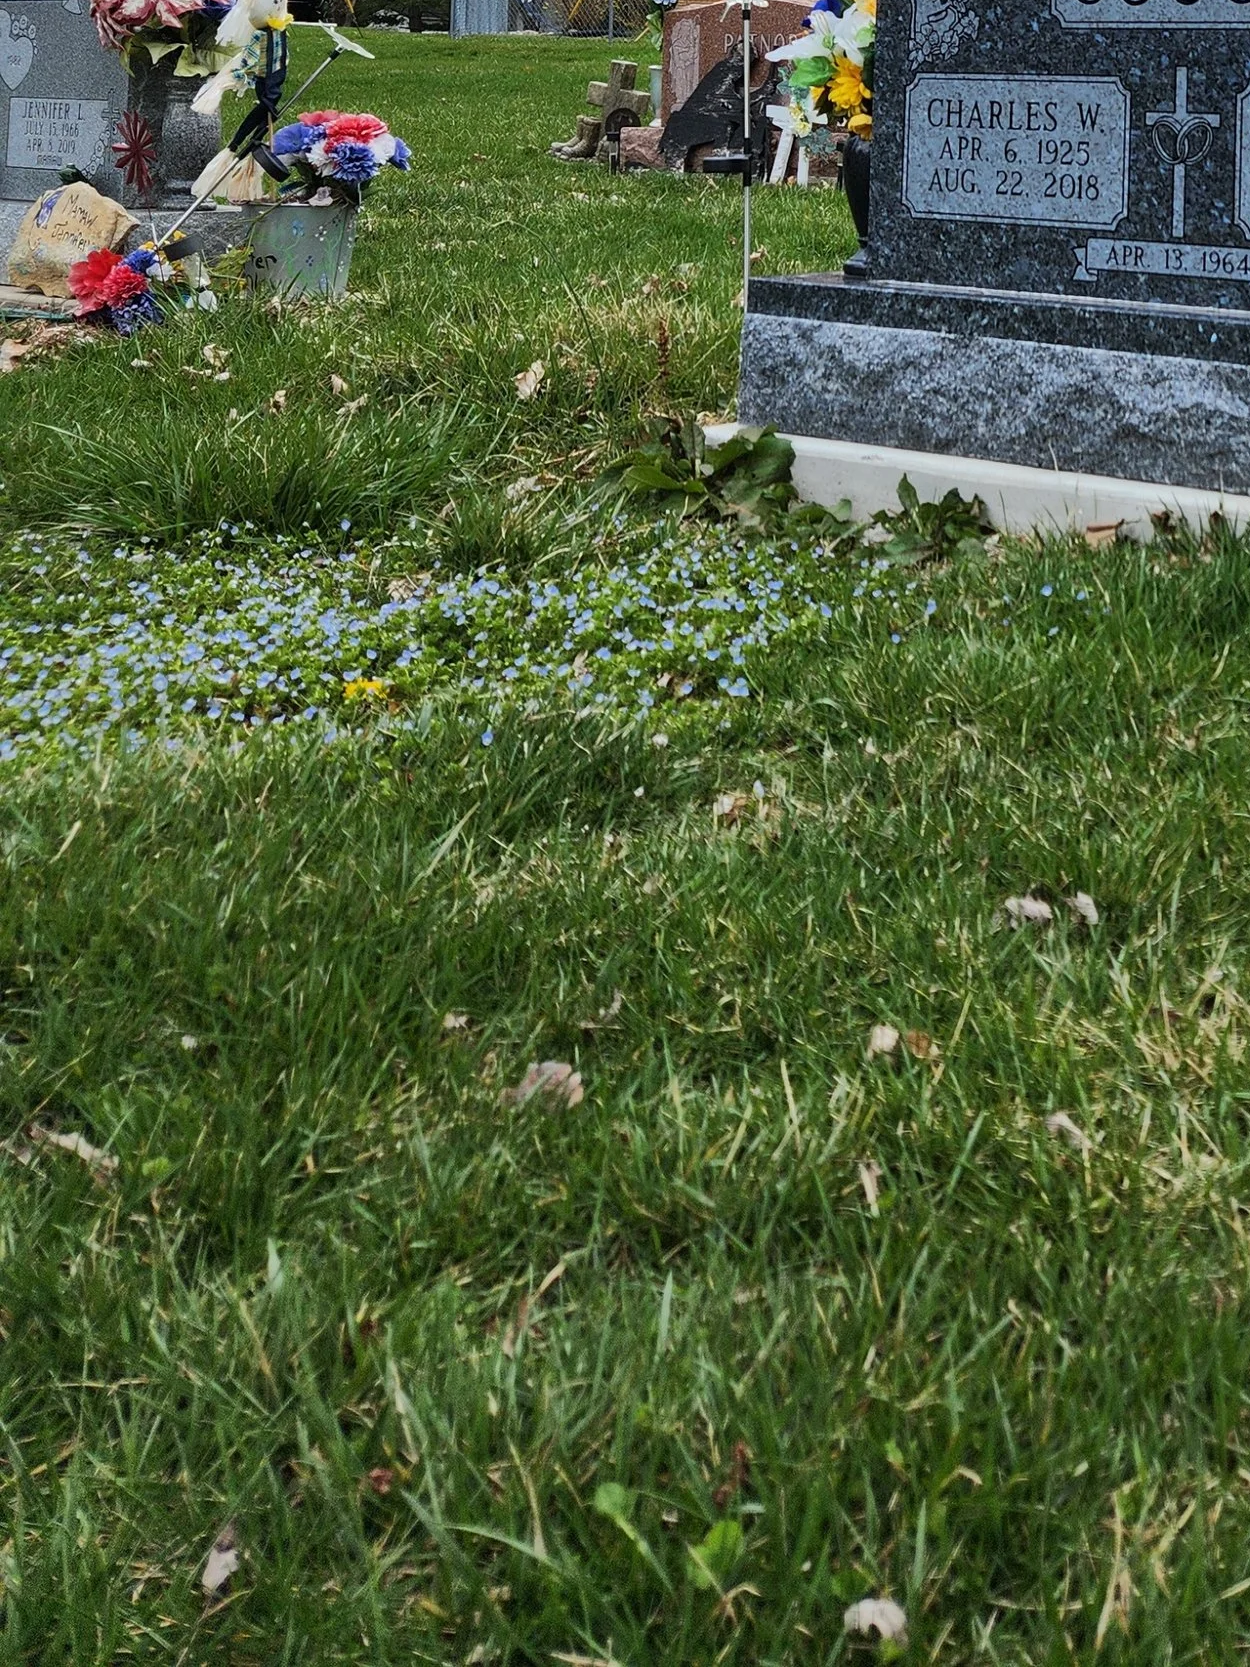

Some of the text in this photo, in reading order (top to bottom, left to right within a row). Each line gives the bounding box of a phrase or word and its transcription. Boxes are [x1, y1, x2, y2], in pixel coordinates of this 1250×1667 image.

[22, 101, 70, 120] JENNIFER
[927, 98, 1105, 133] CHARLES W.
[24, 121, 43, 135] JULY
[61, 123, 80, 137] 1966
[939, 137, 989, 162] APR.
[1037, 139, 1090, 166] 1925
[928, 168, 982, 194] AUG.
[1044, 173, 1100, 200] 2018
[1106, 245, 1151, 268] APR.
